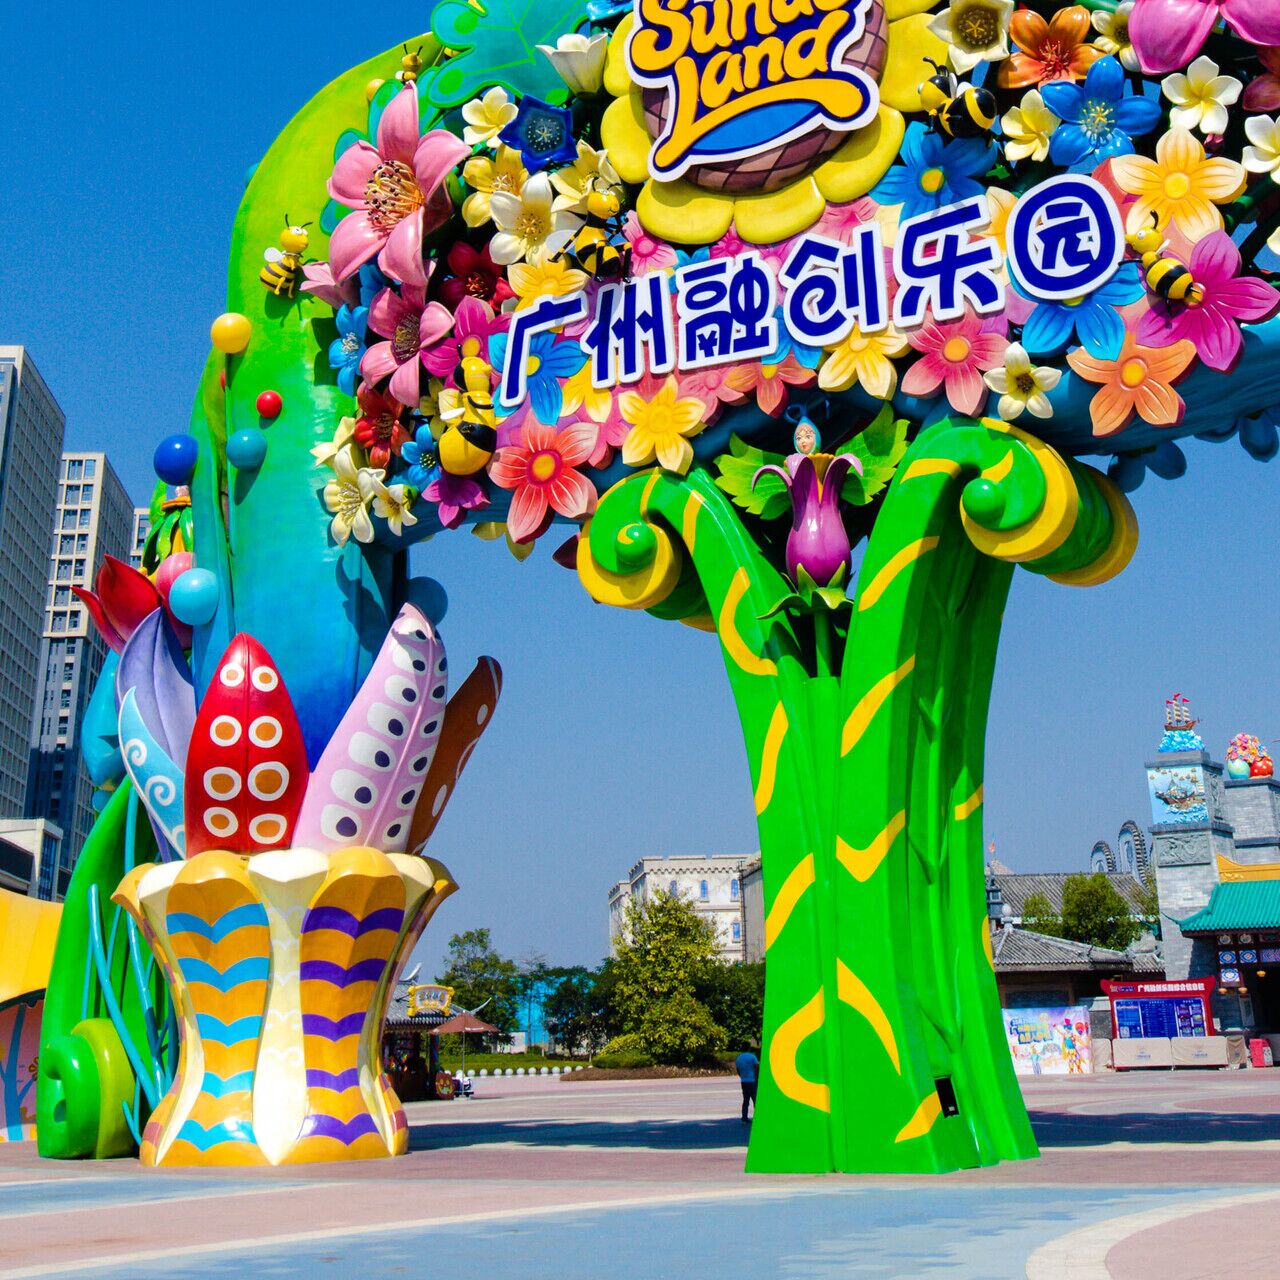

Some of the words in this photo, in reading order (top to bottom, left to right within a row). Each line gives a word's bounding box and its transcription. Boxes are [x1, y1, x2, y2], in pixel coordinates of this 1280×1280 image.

[653, 8, 870, 173] Land
[502, 180, 1119, 403] 广州融创乐园
